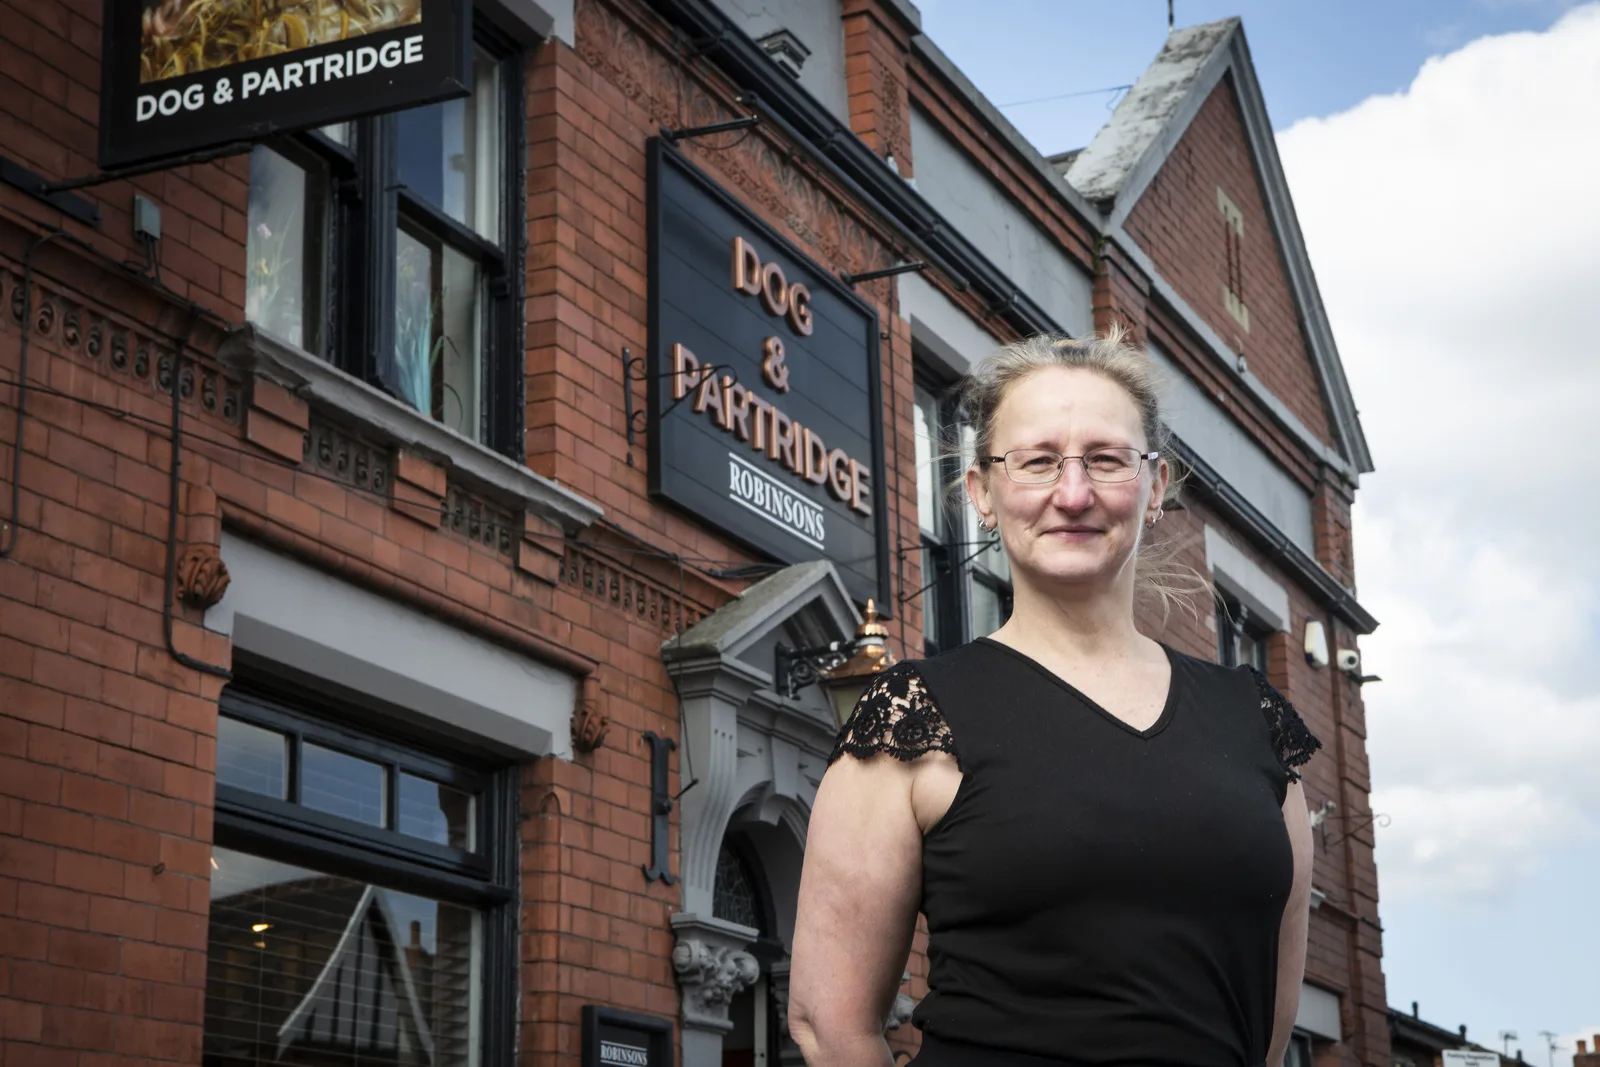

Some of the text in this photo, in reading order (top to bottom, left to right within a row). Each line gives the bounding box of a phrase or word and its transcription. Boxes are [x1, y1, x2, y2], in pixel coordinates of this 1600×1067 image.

[136, 35, 424, 122] DOG & PARTRIDGE
[733, 236, 813, 336] DOG
[763, 336, 790, 393] &
[671, 342, 873, 517] PARTRIDGE
[729, 461, 825, 542] ROBINSONS
[600, 1045, 648, 1066] ROBINSONS
